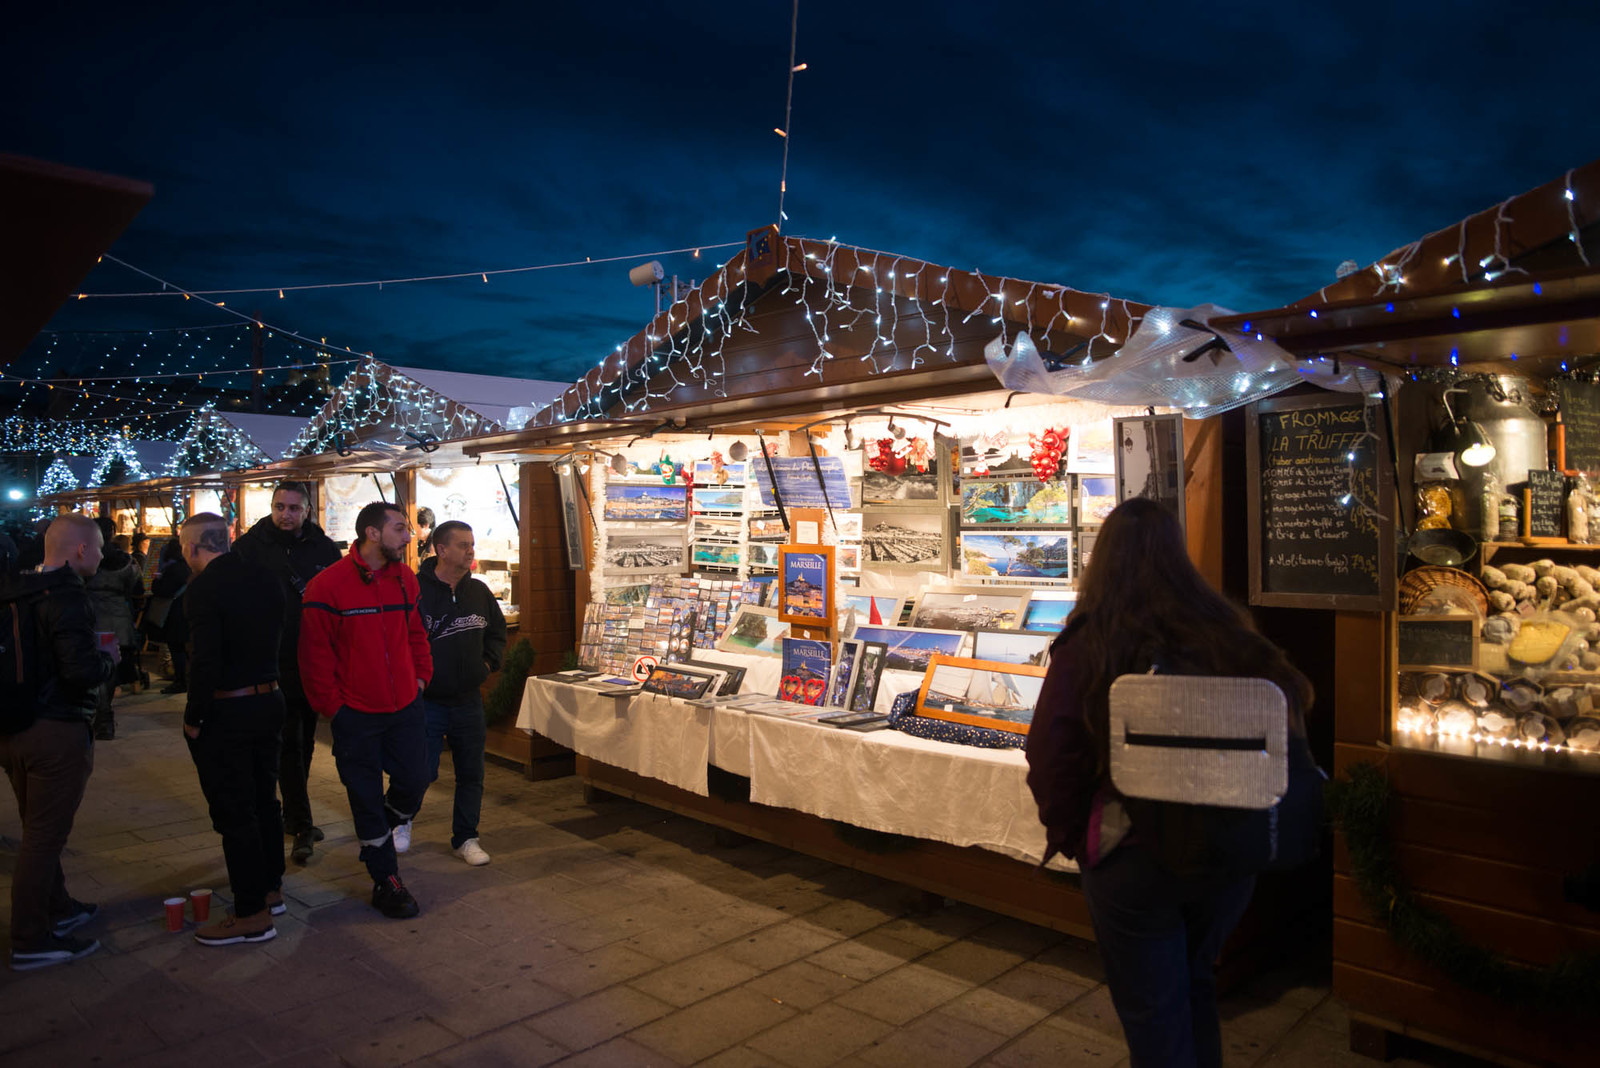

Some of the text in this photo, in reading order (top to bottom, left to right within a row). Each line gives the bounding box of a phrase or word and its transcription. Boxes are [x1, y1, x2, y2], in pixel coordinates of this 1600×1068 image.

[1272, 432, 1365, 452] LA TRUFFE
[790, 560, 822, 570] MARSEILLE
[793, 648, 825, 659] MARSEILLE
